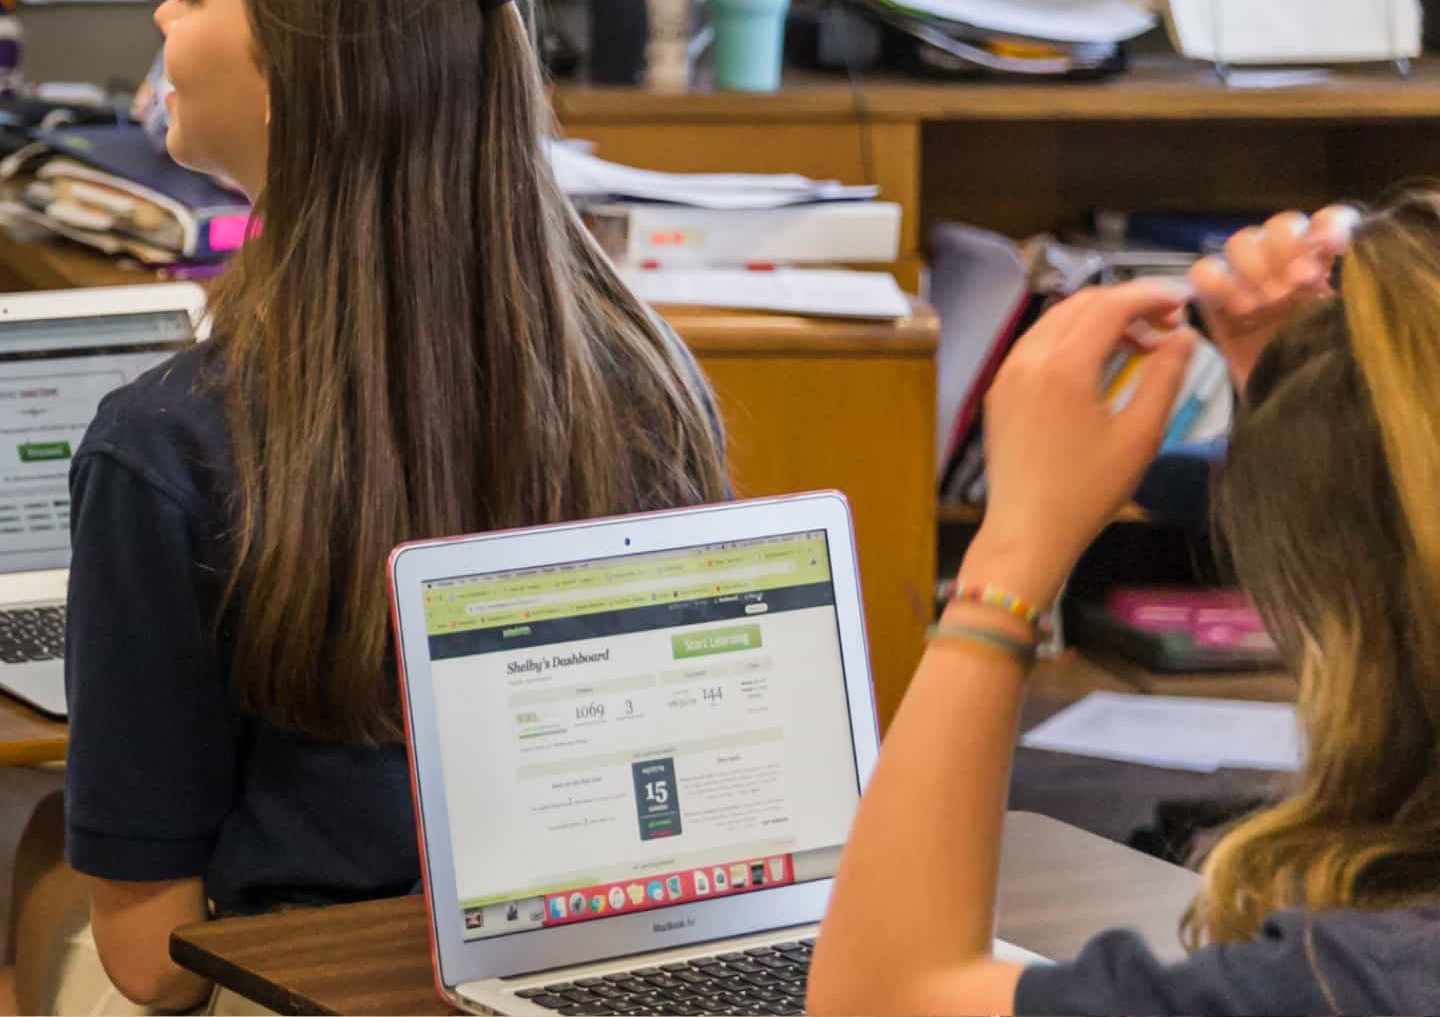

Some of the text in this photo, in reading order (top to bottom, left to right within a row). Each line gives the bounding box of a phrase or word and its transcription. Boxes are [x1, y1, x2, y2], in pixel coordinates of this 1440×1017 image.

[506, 647, 609, 675] Shelby's Dashboard
[702, 686, 722, 700] 144
[575, 697, 633, 719] 1069 3
[644, 780, 668, 803] 15
